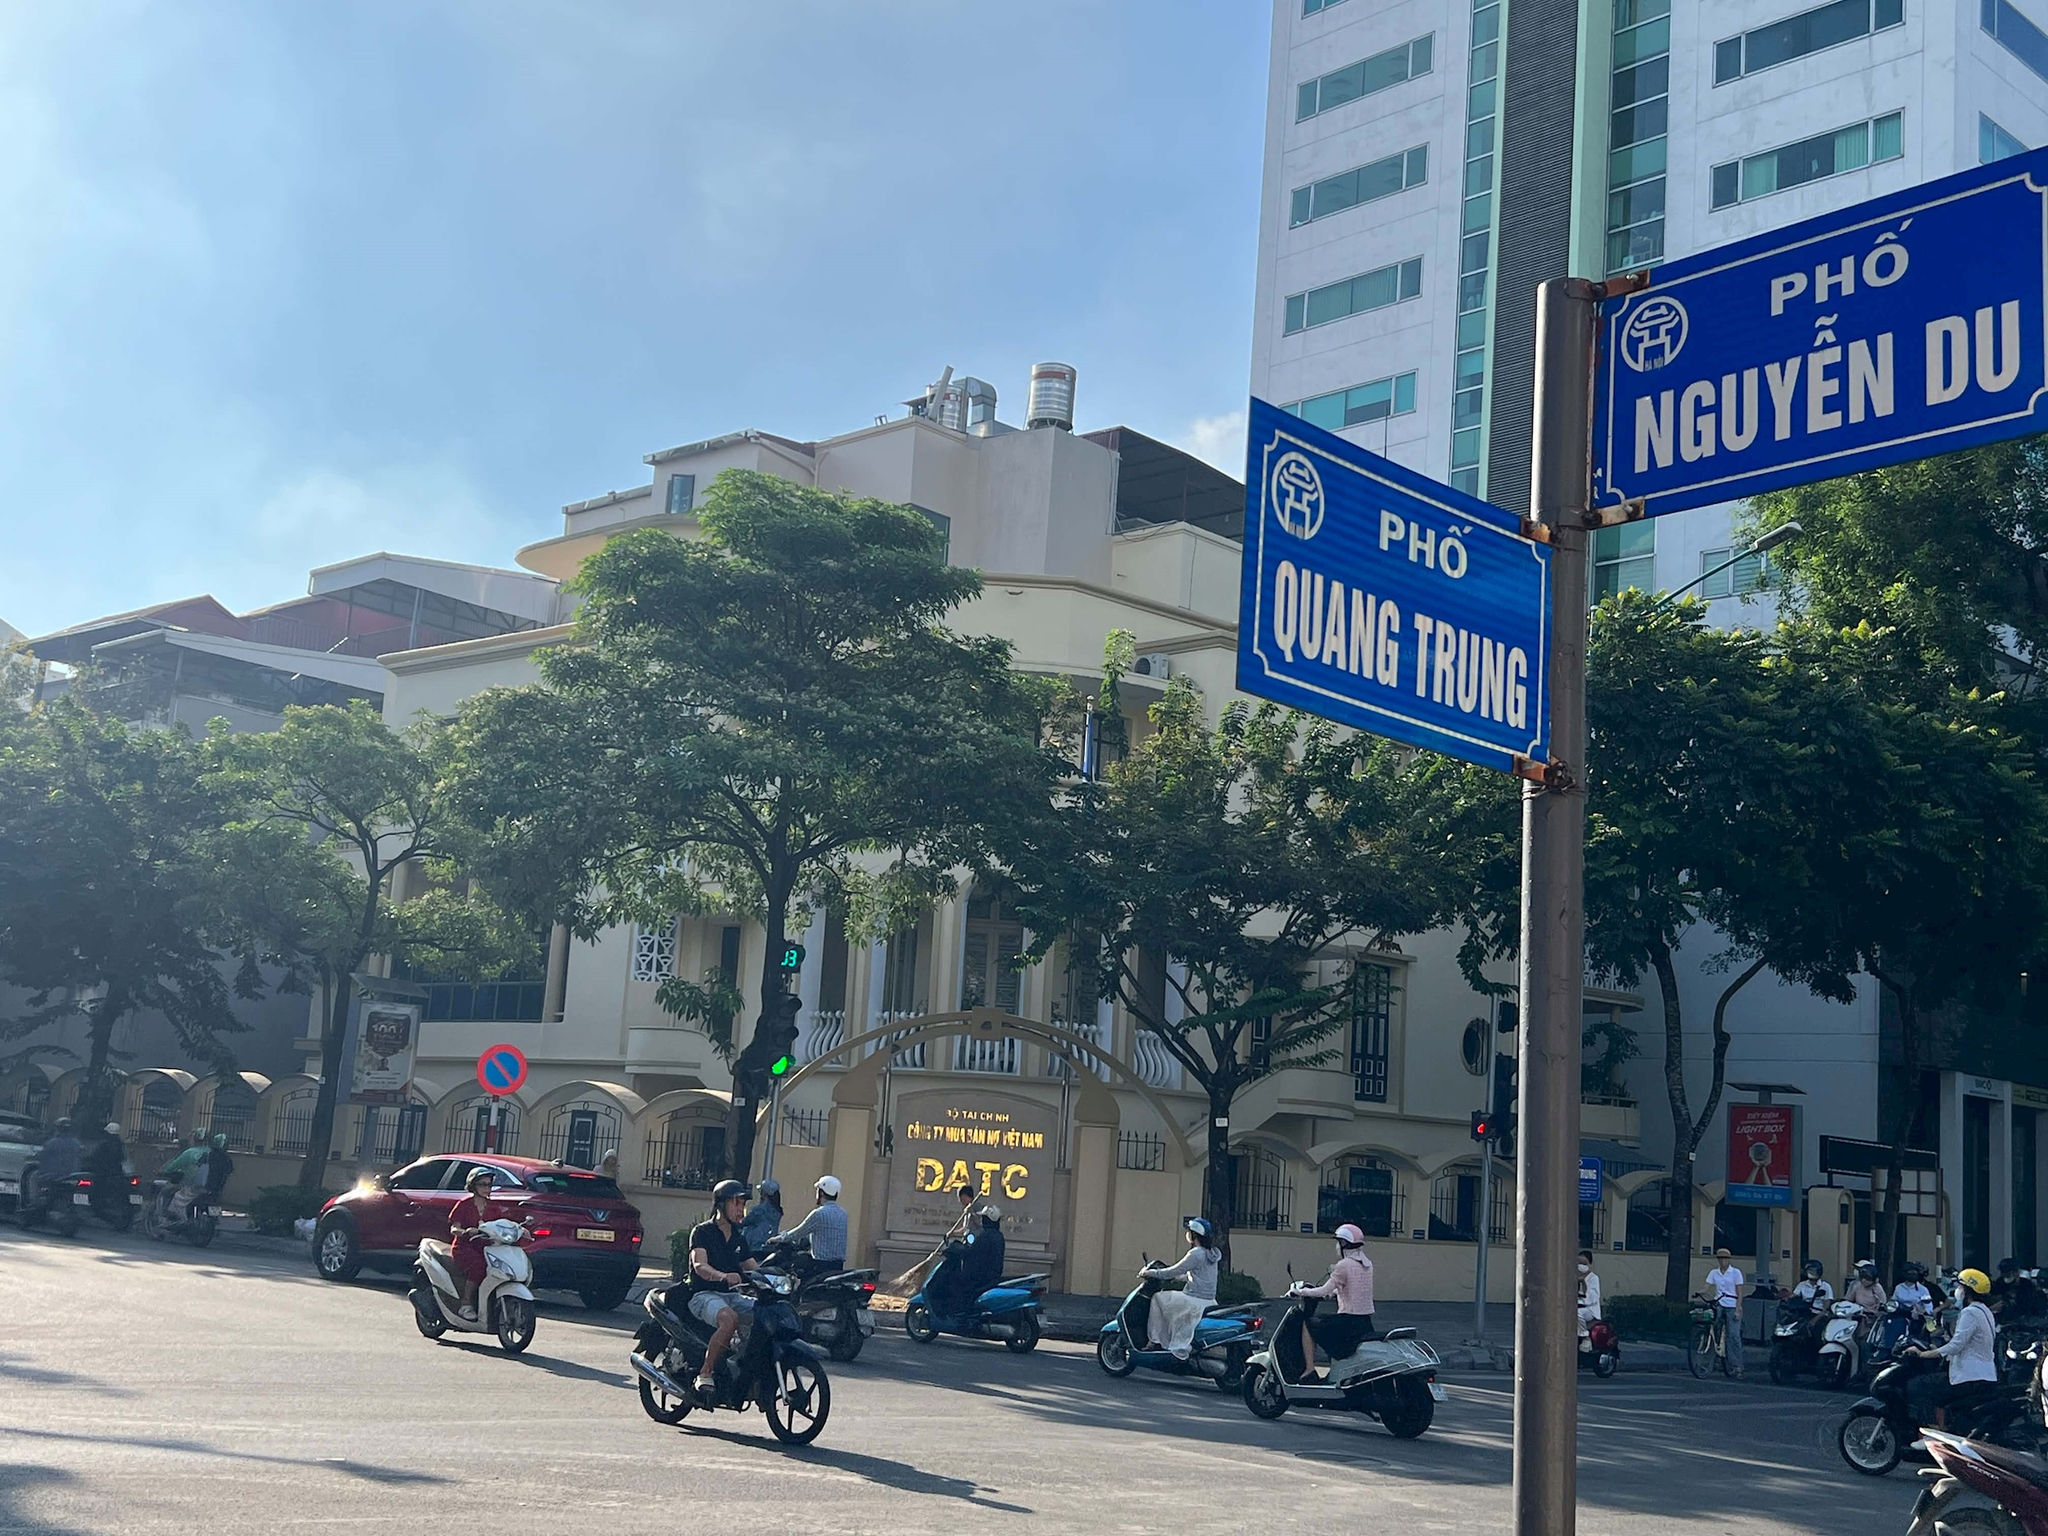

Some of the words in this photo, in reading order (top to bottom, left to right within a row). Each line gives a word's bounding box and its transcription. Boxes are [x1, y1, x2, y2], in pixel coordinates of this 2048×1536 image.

[1771, 218, 1914, 316] PHỐ
[1634, 312, 1894, 473] NGUYỄN
[1925, 299, 2020, 406] DU
[1379, 509, 1474, 579] PHỐ
[1273, 560, 1400, 688] QUANG
[1414, 612, 1528, 730] TRUNG
[933, 1125, 946, 1140] TY
[1021, 1132, 1044, 1149] NAM
[980, 1112, 1009, 1122] CHNH
[1736, 1125, 1763, 1134] LIGHT
[1764, 1124, 1785, 1133] BOX
[915, 1157, 1029, 1199] DATC
